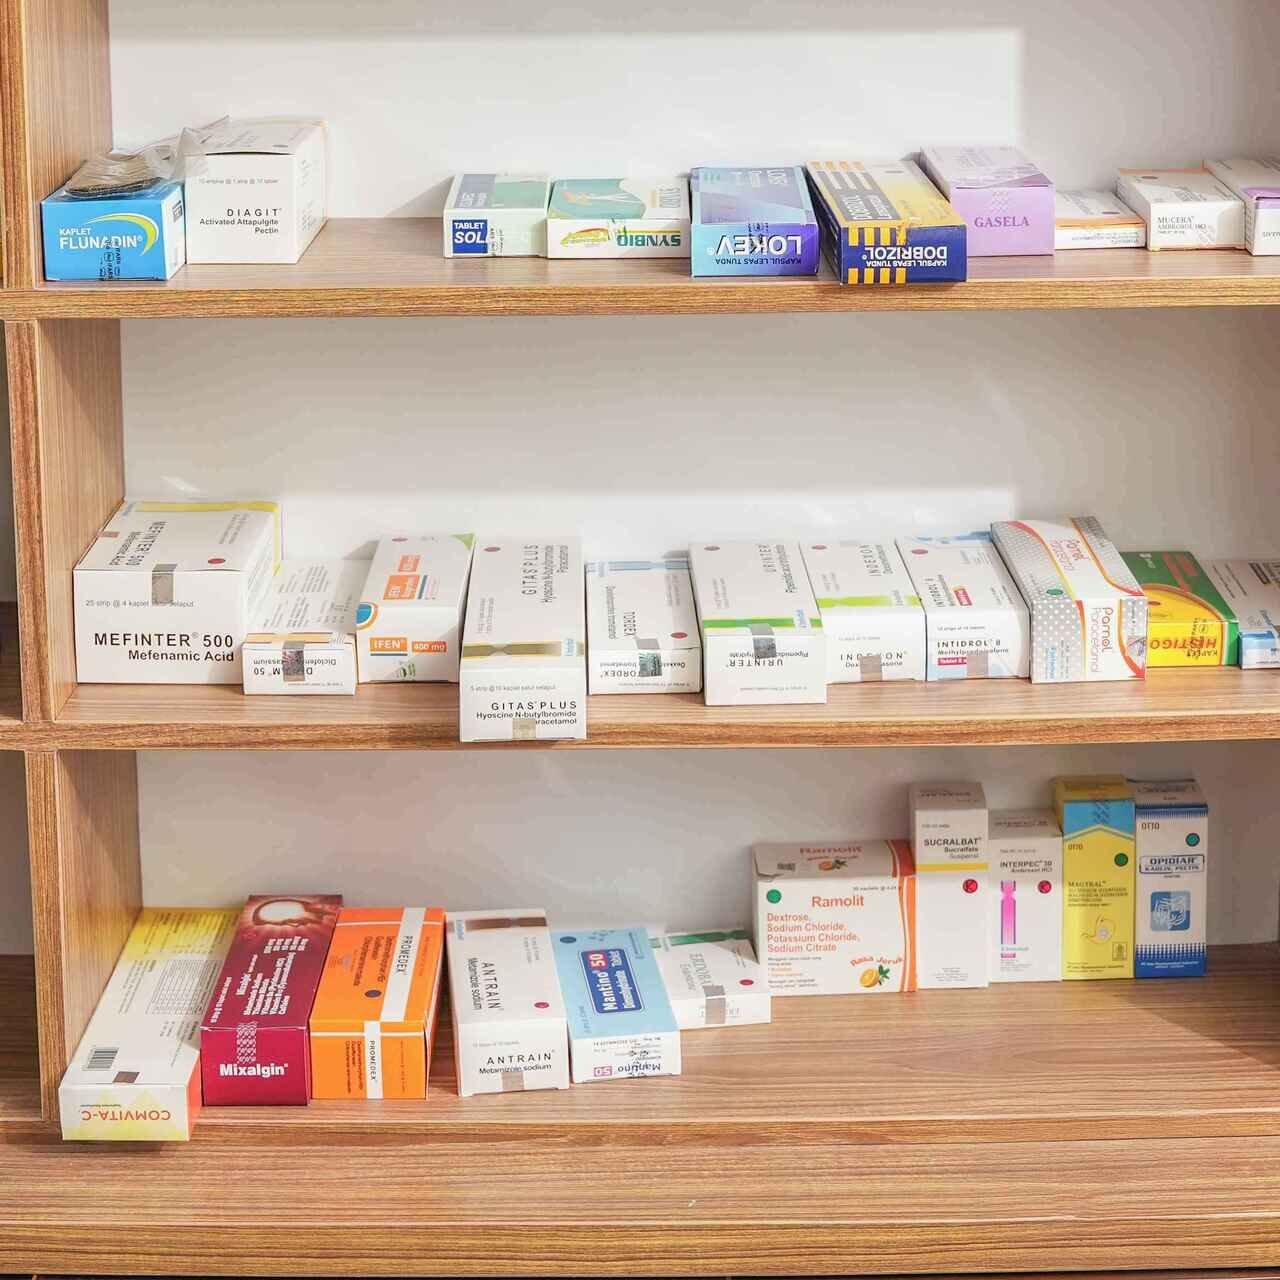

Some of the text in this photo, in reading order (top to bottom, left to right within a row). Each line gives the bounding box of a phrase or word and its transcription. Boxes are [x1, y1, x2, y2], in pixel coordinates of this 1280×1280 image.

[226, 208, 279, 217] DIAGIT
[199, 218, 279, 227] Activated Attapulgite
[454, 222, 484, 230] TABLET
[974, 217, 1030, 228] GASELA
[59, 228, 92, 236] KAPLET
[59, 236, 138, 250] FLUNADIN
[716, 235, 803, 255] LOKEV
[865, 246, 948, 260] DOBRIZOL
[1102, 607, 1114, 654] Pamol
[94, 632, 234, 648] MEFINTER 500
[374, 639, 400, 650] IFEN
[937, 639, 989, 648] INTIDROL
[128, 650, 234, 662] Mefenamic Acid
[491, 701, 577, 712] GITAS PLUS
[477, 710, 577, 721] Hyoscine N-butylbromide
[535, 716, 577, 725] aracetamol
[924, 838, 978, 846] SUCRALBAT
[812, 895, 864, 908] Ramolit
[768, 913, 811, 923] Dextrose,
[768, 923, 847, 932] Sodium Chloride,
[768, 933, 860, 943] Potassium Chloride,
[768, 943, 837, 953] Sodium Citrate
[396, 936, 413, 976] PROMEDEX
[483, 962, 501, 1010] ANTRAIN
[591, 953, 618, 1012] Mantino 50
[487, 1051, 552, 1065] ANTRAIN
[220, 1063, 285, 1079] Mixalgin
[479, 1063, 552, 1075] Metamizole sodium
[81, 1110, 171, 1121] COMVITA-C
